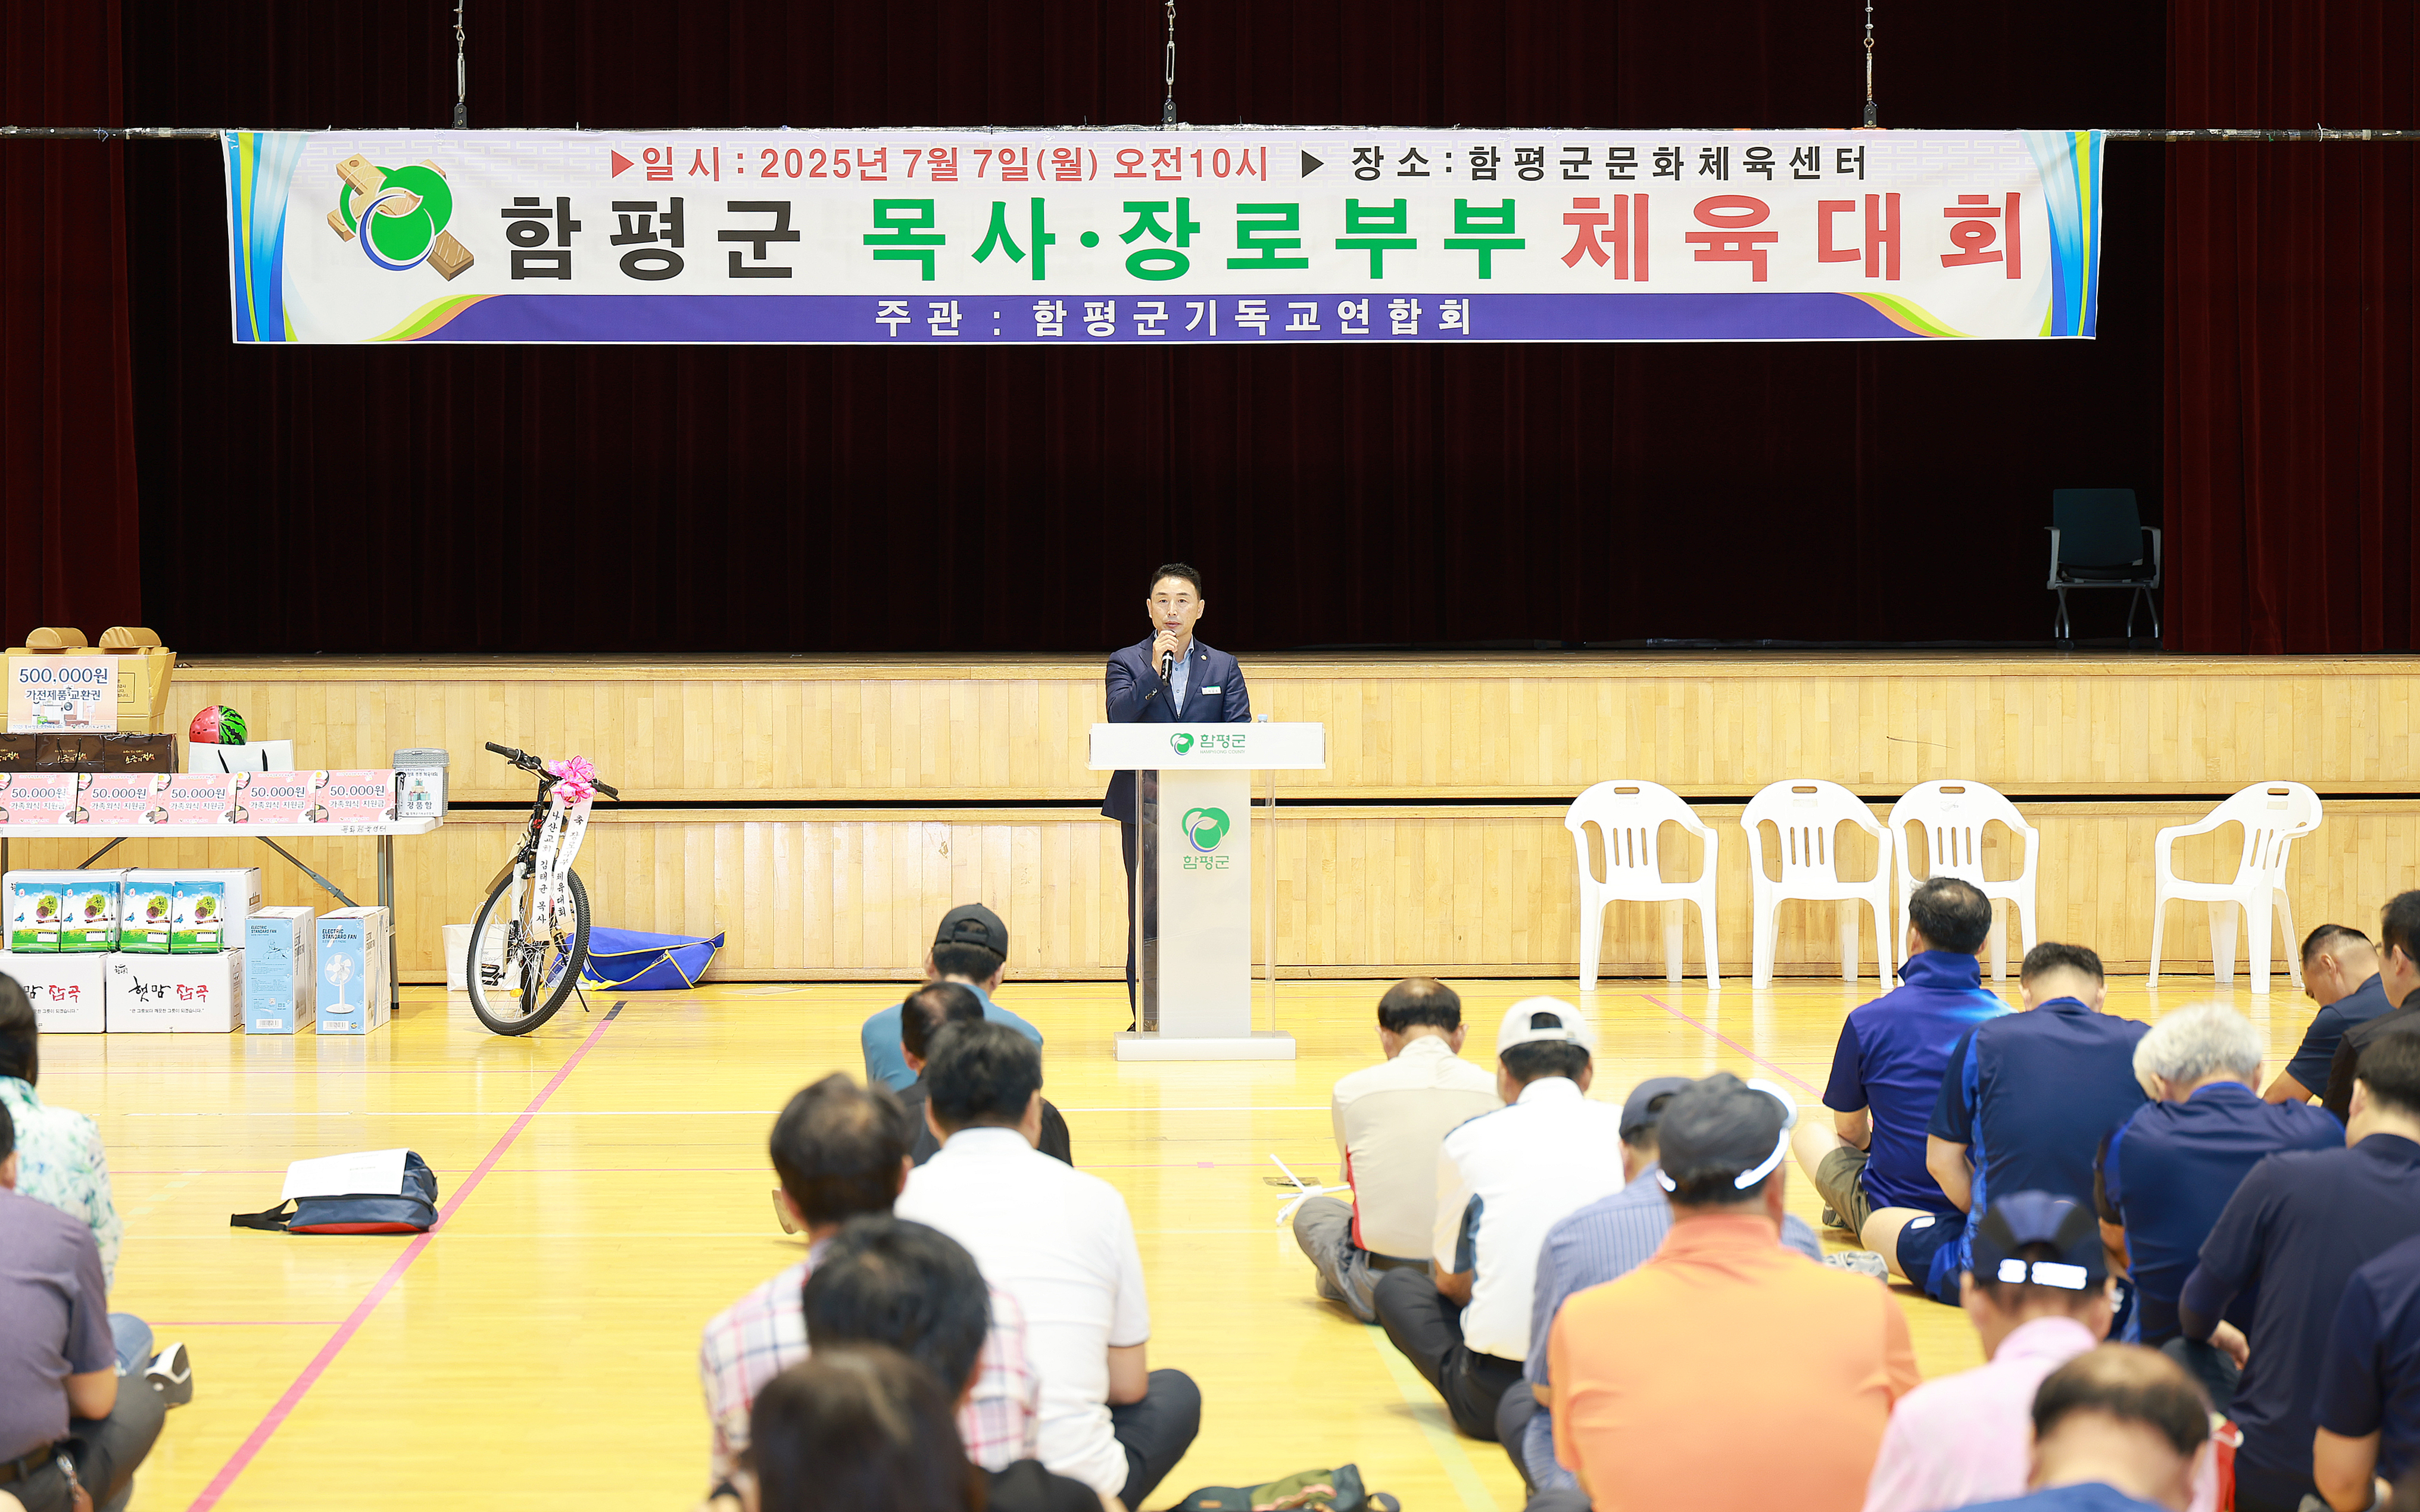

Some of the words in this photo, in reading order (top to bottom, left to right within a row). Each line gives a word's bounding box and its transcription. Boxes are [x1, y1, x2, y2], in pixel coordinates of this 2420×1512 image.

[762, 148, 888, 182] 2025년
[904, 148, 959, 182] 7월
[975, 148, 1098, 182] 7일(월)
[1115, 147, 1267, 182] 오전10시
[1470, 146, 1865, 182] 함평군문화체육센터
[501, 197, 801, 282] 함평군
[1562, 192, 2022, 283] 체육대회
[875, 299, 962, 337] 주관
[1032, 298, 1470, 337] 함평군기독교연합회
[19, 668, 108, 684] 500,000원
[26, 690, 67, 701] 가전제품
[70, 689, 101, 701] 교환권
[1200, 734, 1246, 748] 함평군
[11, 788, 66, 798] 50,000원
[92, 788, 146, 799] 50,000원
[171, 788, 226, 799] 50,000원
[251, 786, 305, 798] 50,000원
[330, 785, 385, 797] 50,000원
[43, 802, 66, 810] 지원금
[124, 802, 146, 810] 지원금
[202, 801, 226, 810] 지원금
[283, 800, 305, 809] 지원금
[363, 799, 385, 808] 지원금
[407, 801, 432, 810] 경품함
[573, 814, 584, 826] 축
[542, 810, 560, 852] 나산교회
[1183, 855, 1230, 870] 함평군
[556, 871, 566, 917] 체육대회
[536, 901, 547, 924] 목사
[23, 985, 43, 999] 맘
[49, 984, 81, 1002] 잡곡
[128, 975, 171, 1002] 햇맘
[176, 983, 209, 1002] 잡곡
